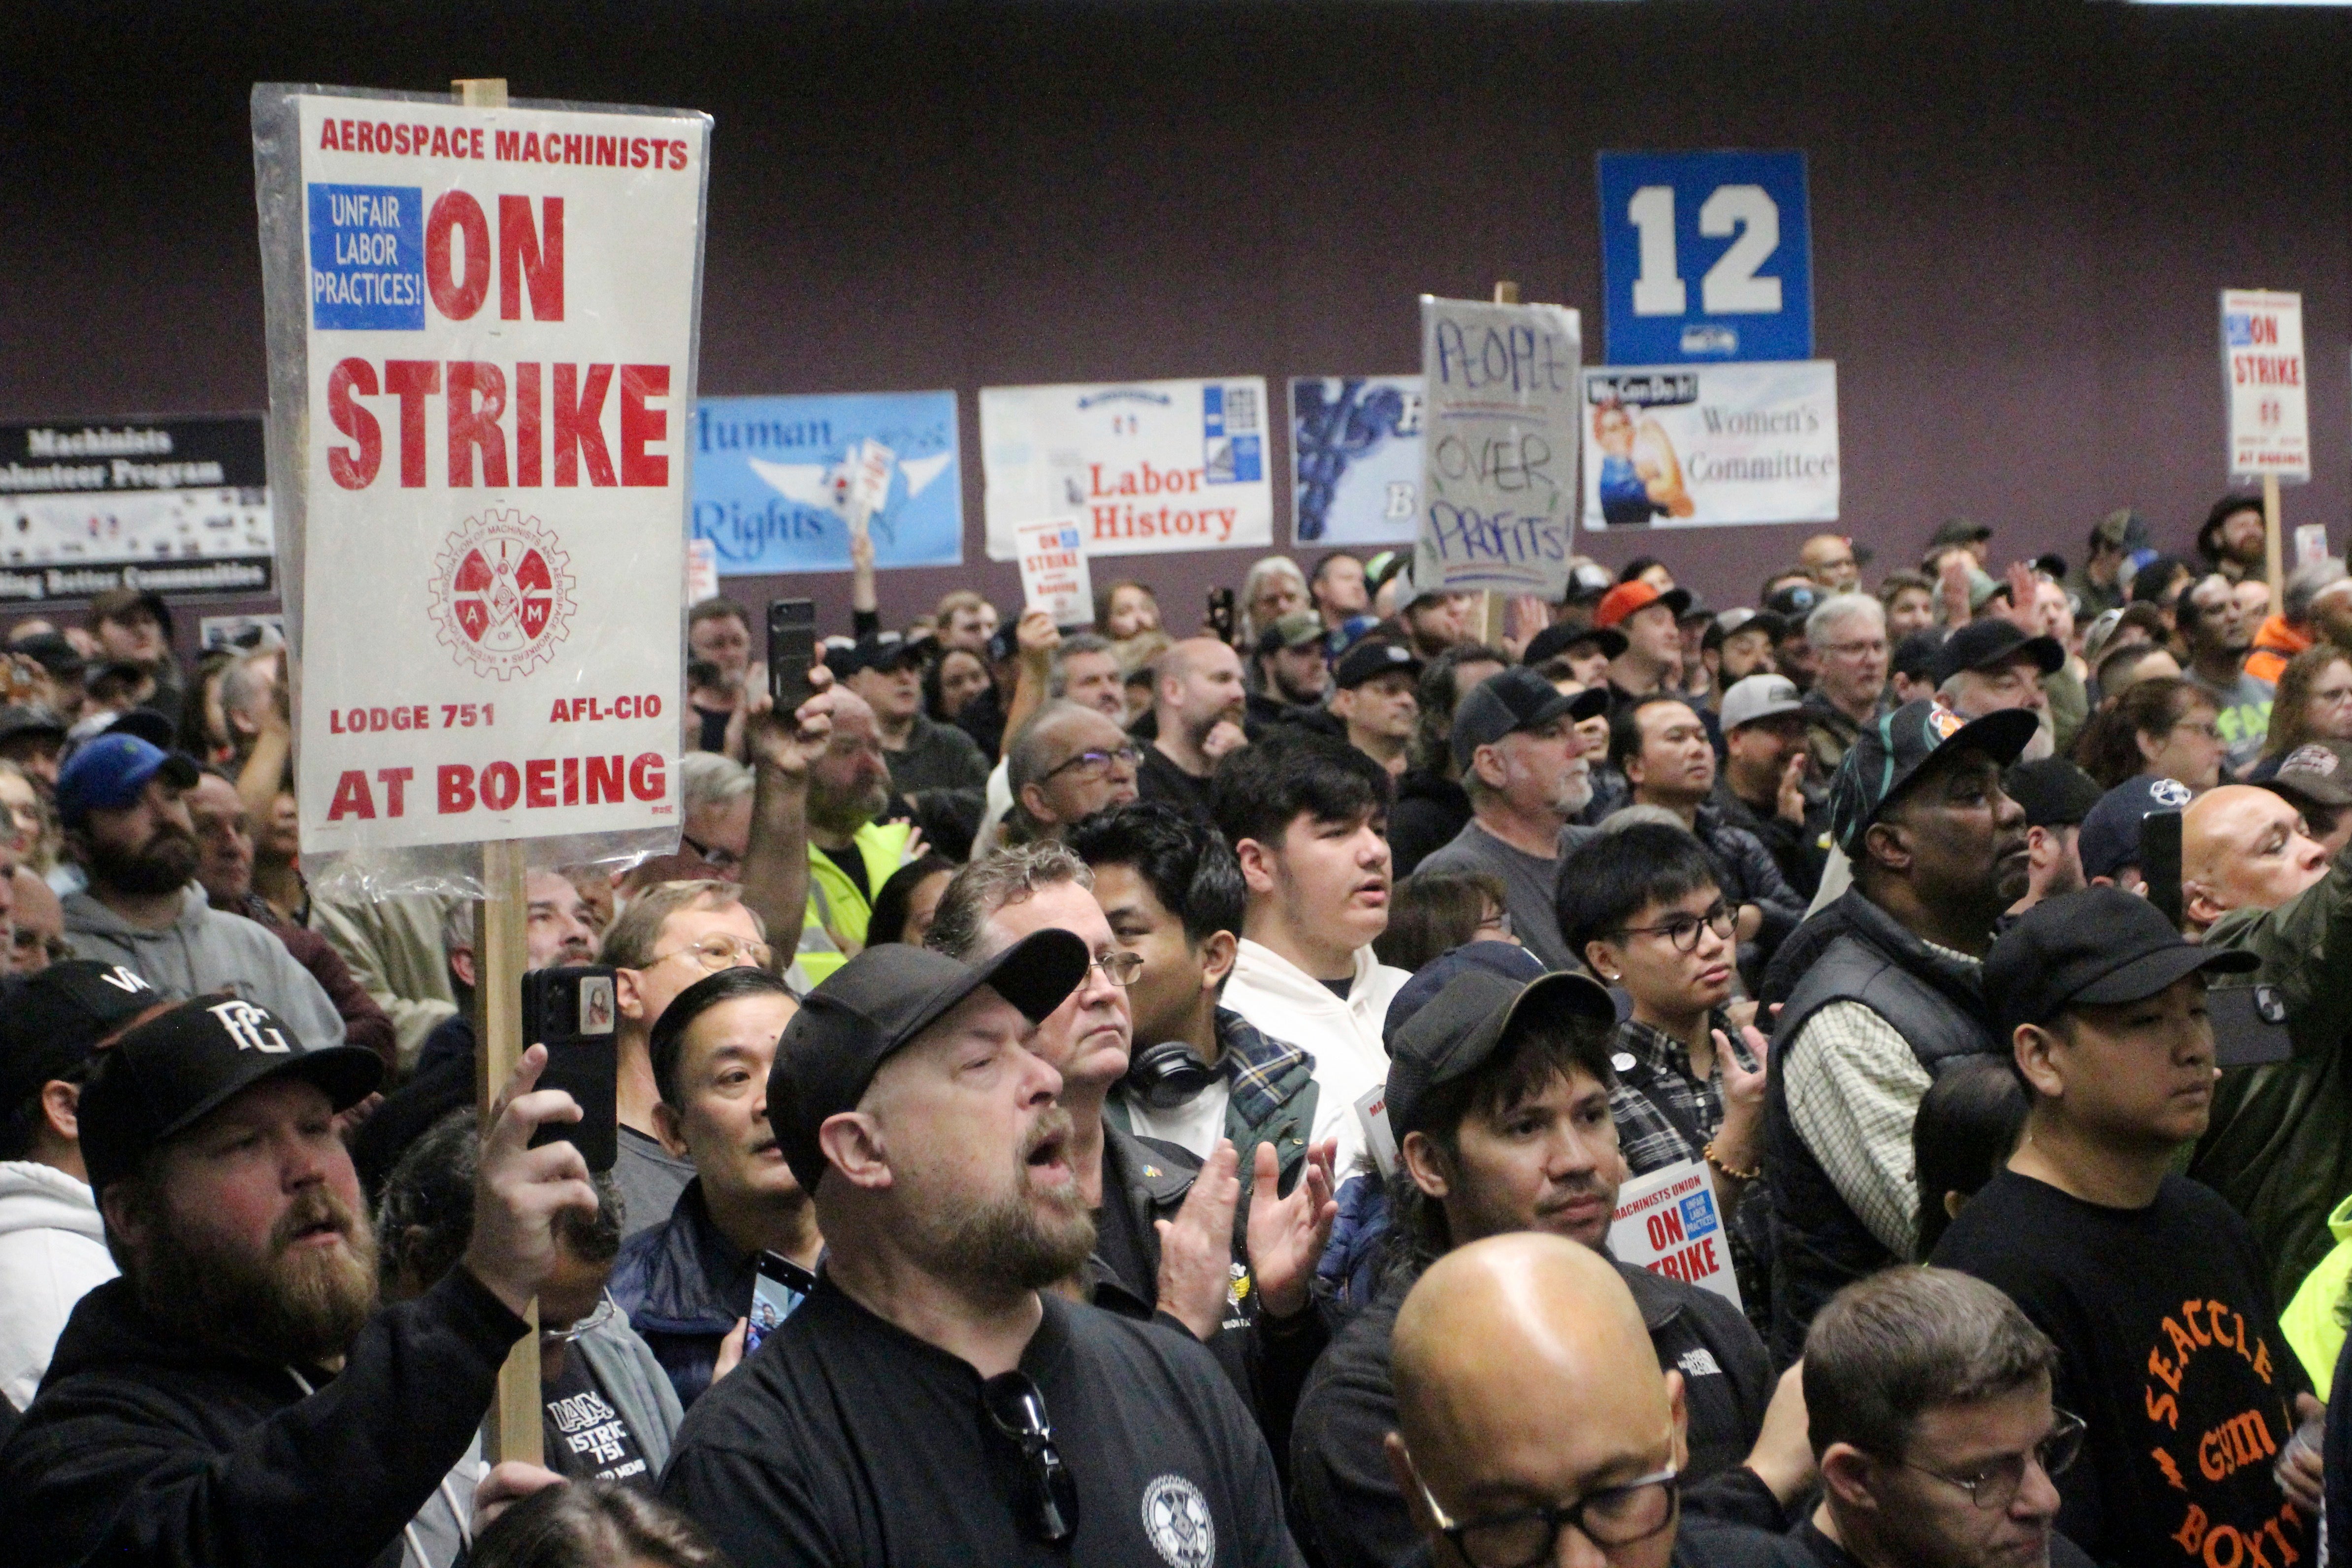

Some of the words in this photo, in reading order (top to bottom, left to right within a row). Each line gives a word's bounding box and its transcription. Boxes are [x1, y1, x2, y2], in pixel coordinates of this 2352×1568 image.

[321, 117, 484, 160] AEROSPACE
[495, 130, 688, 171] MACHINISTS
[331, 194, 400, 229] UNFAIR
[335, 233, 398, 265] LABOR
[425, 189, 565, 322] ON
[1627, 184, 1783, 316] 12
[314, 271, 422, 305] PRACTICES!
[2251, 315, 2278, 344] ON
[2234, 355, 2301, 386] STRIKE
[327, 357, 671, 490] STRIKE
[1702, 405, 1820, 435] Women's
[1088, 461, 1206, 497] Labor
[1435, 433, 1555, 491] OVER
[1687, 453, 1836, 483] Committee
[488, 524, 541, 547] MACHINISTS
[693, 497, 824, 562] Rights
[1091, 503, 1238, 541] History
[541, 545, 555, 565] AND
[465, 605, 479, 624] A
[527, 605, 542, 622] M
[551, 566, 564, 631] AEROSPACE
[511, 631, 553, 663] WORKERS
[330, 705, 429, 734] LODGE
[441, 702, 494, 729] 751
[550, 693, 662, 723] AFL-CIO
[327, 767, 414, 821] AT
[437, 751, 666, 815] BOEING
[1611, 1187, 1671, 1222] MACHINISTS
[1671, 1174, 1701, 1196] UNION
[1646, 1207, 1684, 1251] ON
[588, 1440, 625, 1465] 751
